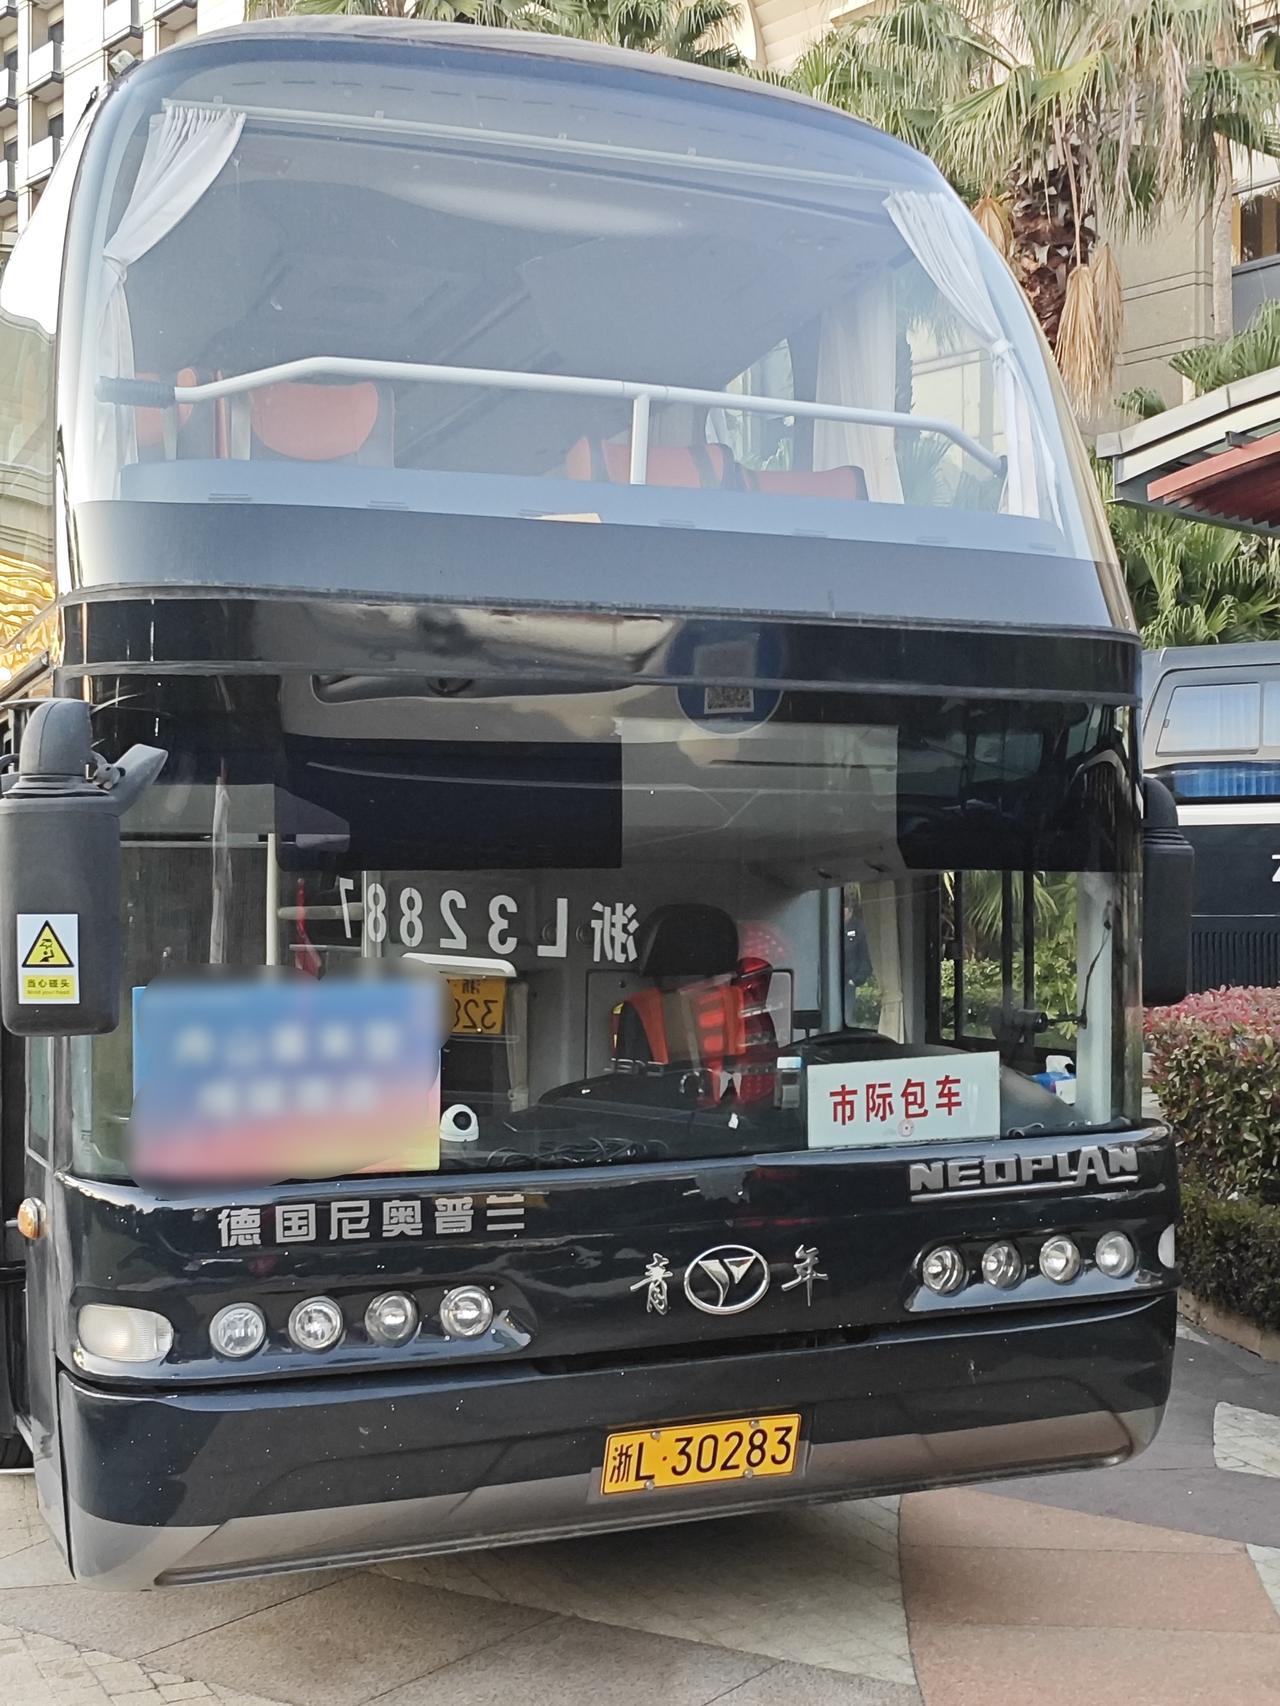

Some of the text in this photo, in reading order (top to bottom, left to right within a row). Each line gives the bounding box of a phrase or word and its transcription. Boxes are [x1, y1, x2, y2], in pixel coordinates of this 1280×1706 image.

[829, 1075, 963, 1126] 市际包车
[909, 1145, 1139, 1190] NEOPLAN
[217, 1194, 525, 1247] 德国尼奥普兰
